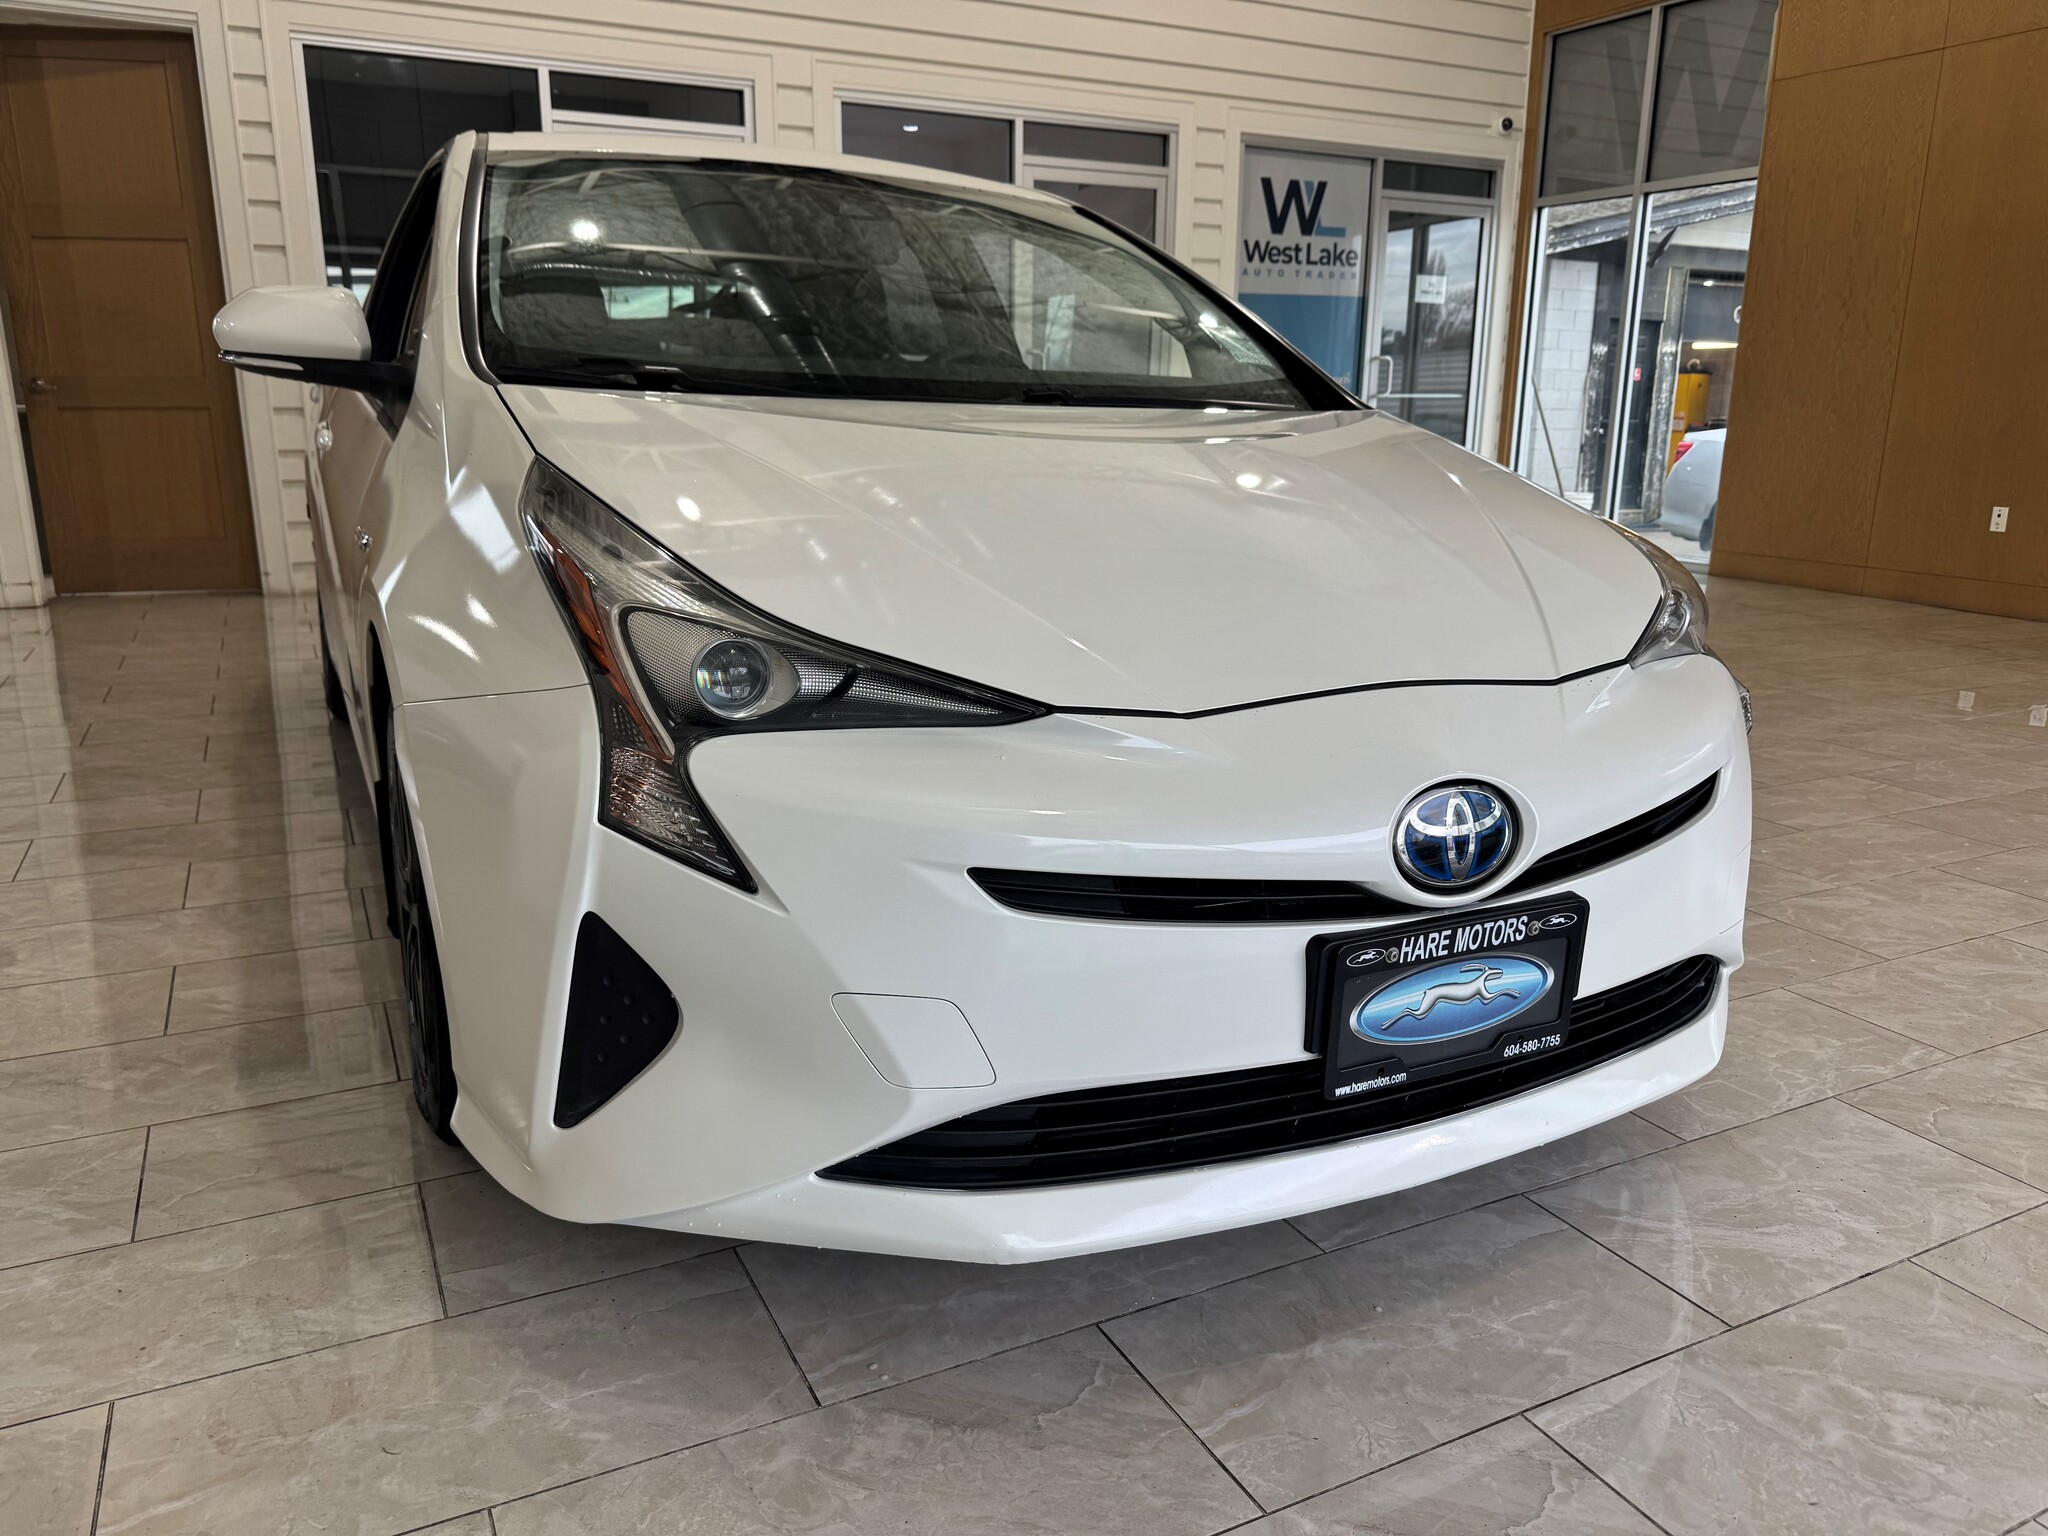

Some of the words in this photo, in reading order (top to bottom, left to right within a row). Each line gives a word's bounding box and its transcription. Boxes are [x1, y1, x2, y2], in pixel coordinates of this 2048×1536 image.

[1242, 267, 1285, 278] AUTO
[1399, 929, 1452, 964] HARE
[1453, 915, 1528, 954] MOTORS
[1503, 1033, 1561, 1058] 604-580-7755
[1334, 1072, 1407, 1097] www.haremotors.com
